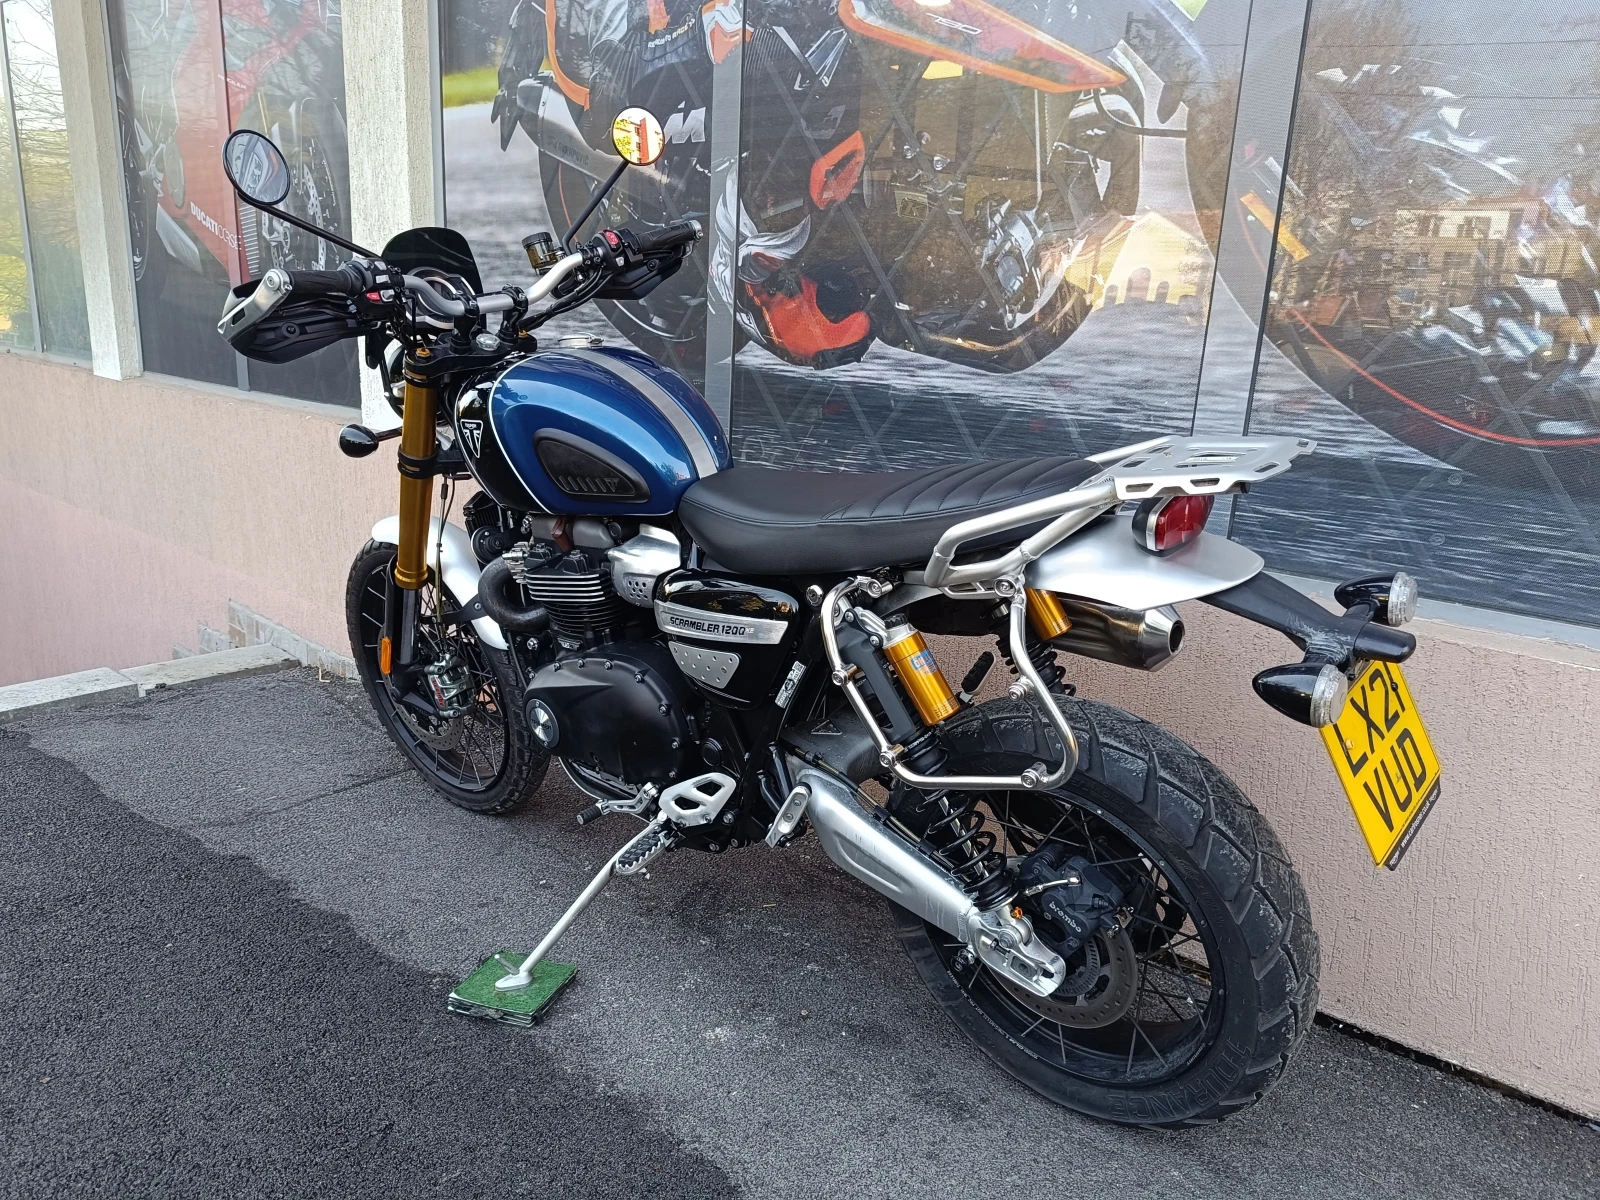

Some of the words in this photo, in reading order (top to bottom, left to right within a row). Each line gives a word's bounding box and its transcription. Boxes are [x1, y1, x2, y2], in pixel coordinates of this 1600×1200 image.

[669, 616, 721, 634] SCRAMBLER
[721, 624, 746, 636] 1200
[1361, 726, 1428, 833] VUD
[1048, 900, 1082, 933] brembo
